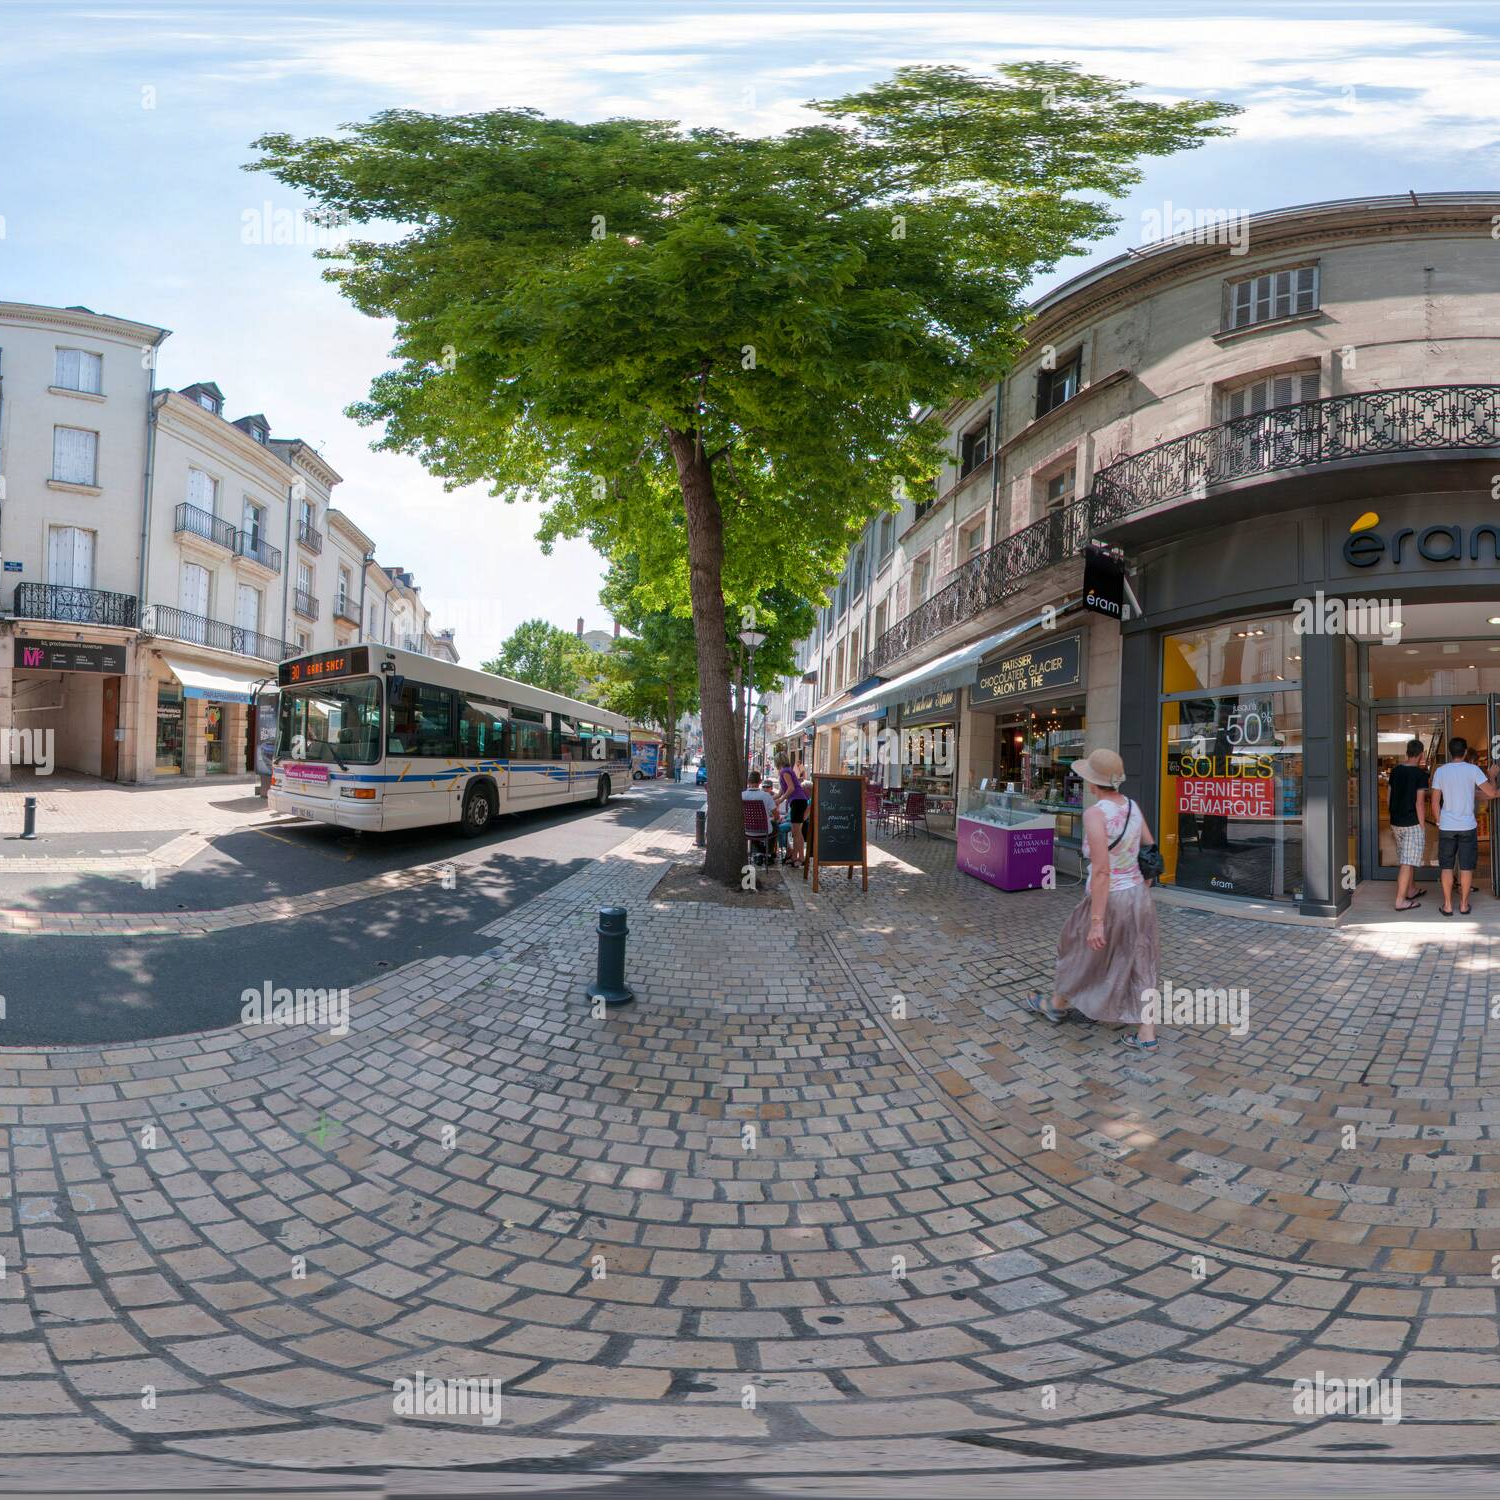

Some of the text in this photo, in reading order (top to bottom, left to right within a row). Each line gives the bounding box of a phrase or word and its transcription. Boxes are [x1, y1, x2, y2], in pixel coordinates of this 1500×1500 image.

[1086, 589, 1120, 615] éram
[291, 665, 300, 681] 30
[326, 658, 345, 672] SNCF
[980, 657, 1063, 689] CHOCOLATIER GLACIER
[1002, 654, 1032, 672] PATISSIER
[993, 681, 1015, 696] SALON
[1018, 680, 1027, 690] DE
[1180, 754, 1274, 778] SOLDES
[1210, 877, 1233, 889] éram
